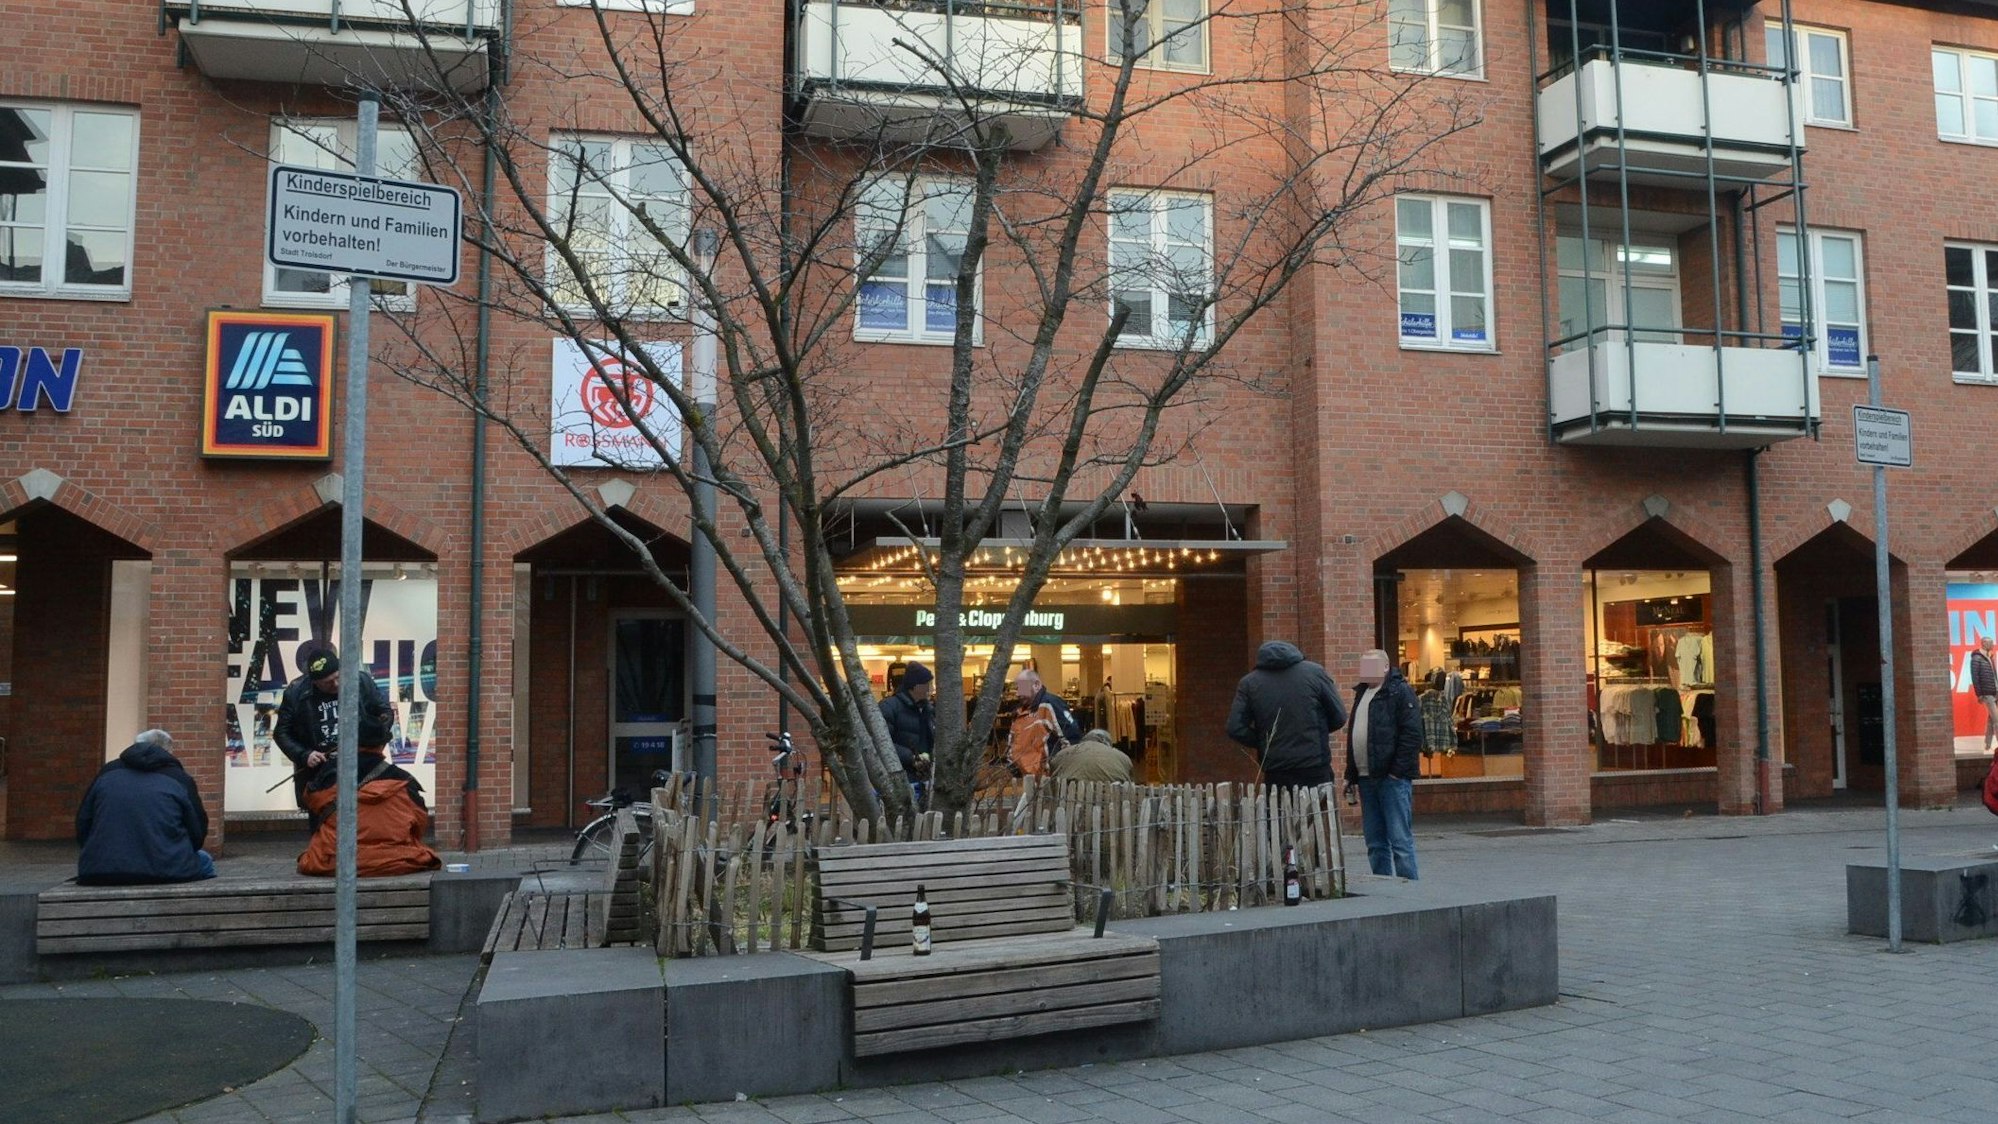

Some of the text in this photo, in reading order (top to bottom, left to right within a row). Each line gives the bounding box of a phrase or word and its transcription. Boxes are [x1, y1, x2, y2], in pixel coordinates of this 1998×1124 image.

[287, 173, 431, 207] Kinderspielbereich
[284, 204, 448, 239] Kindern und Familien
[282, 229, 381, 252] vorbehalten!
[280, 247, 299, 257] Stadt
[386, 259, 446, 273] Der Bürgermeister
[224, 394, 312, 421] ALDI
[251, 421, 284, 438] SÜD
[565, 432, 667, 449] ROSSMAN
[228, 578, 373, 641] NEW
[959, 612, 967, 627] &
[968, 609, 1064, 631] Clopnburg
